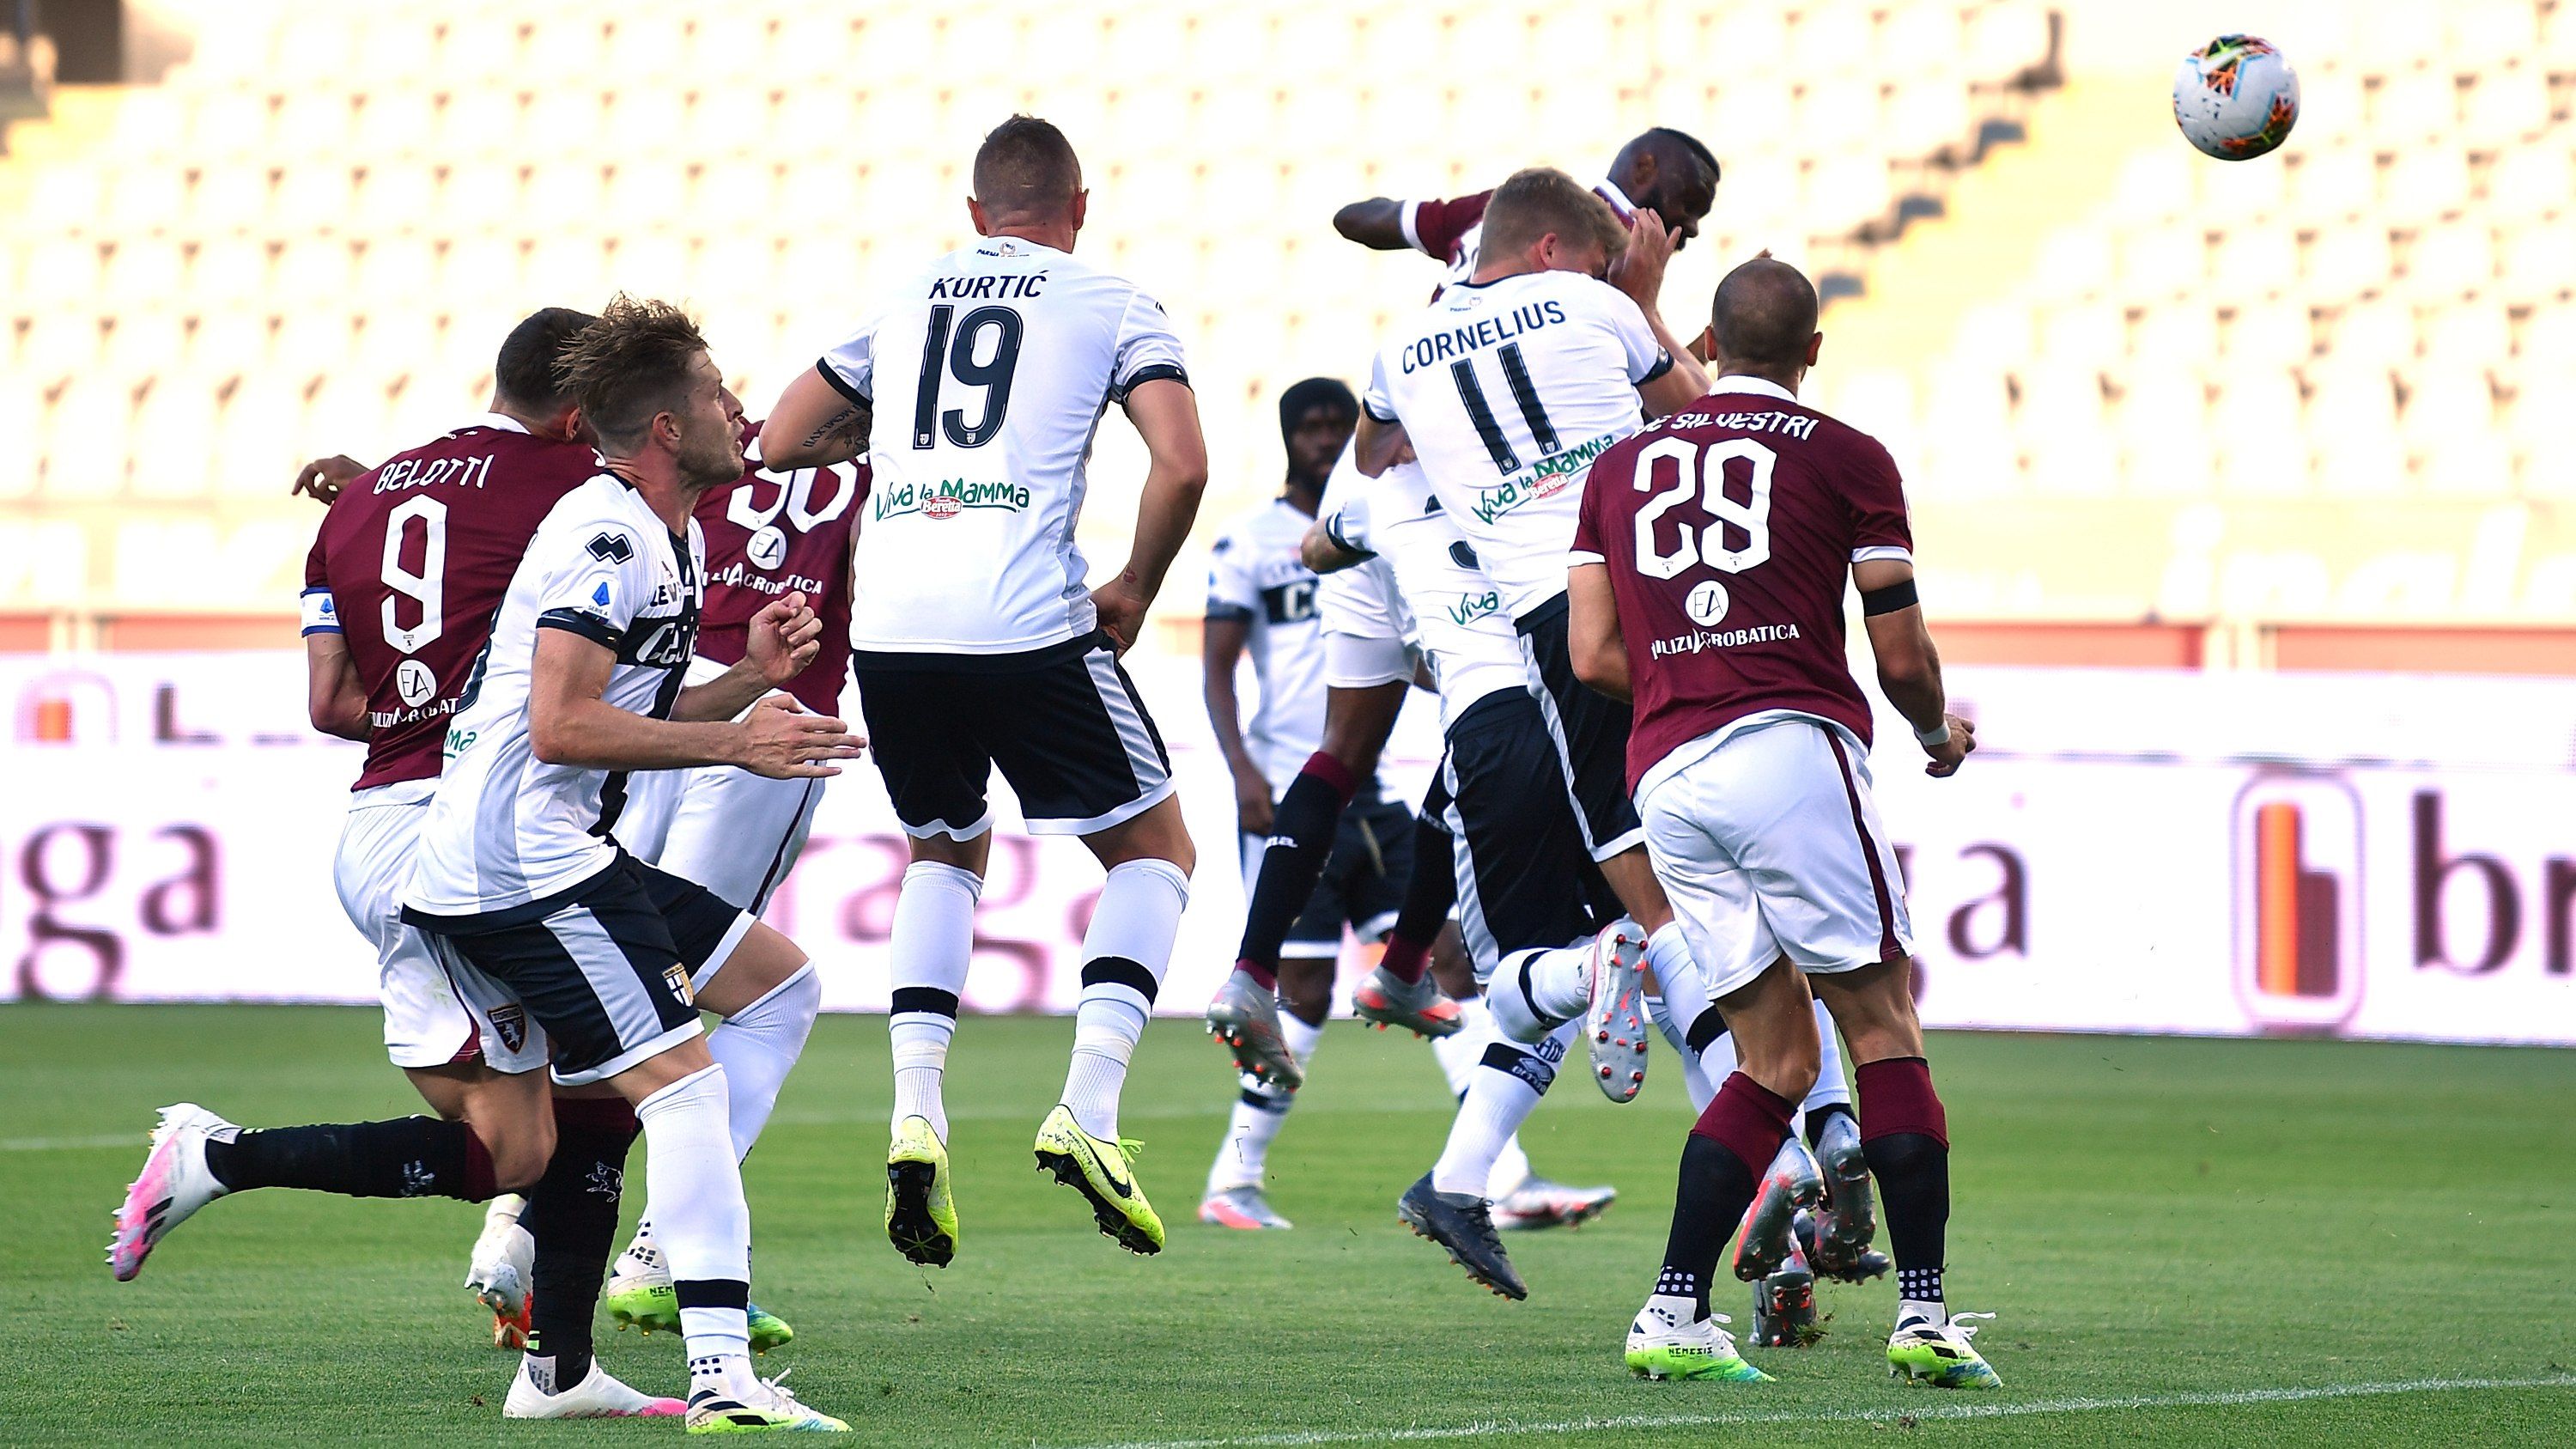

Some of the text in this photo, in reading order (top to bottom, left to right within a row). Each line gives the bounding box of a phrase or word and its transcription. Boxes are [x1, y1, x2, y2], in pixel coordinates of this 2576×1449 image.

[928, 270, 1049, 299] KURTIĆ
[1402, 301, 1566, 374] CORNELIUS
[913, 305, 1024, 450] 19
[1449, 342, 1563, 477] 11
[1671, 411, 1819, 441] SILVESTRI
[373, 454, 495, 496] BELOTTI
[876, 482, 914, 521] Viva
[920, 484, 933, 500] la
[922, 499, 962, 513] Beretta
[1471, 482, 1518, 525] Viva
[1518, 476, 1534, 490] la
[1633, 436, 1777, 580] 29
[380, 494, 447, 654] 9
[1448, 593, 1499, 625] Viva
[649, 1285, 673, 1294] NEM
[1668, 1346, 1713, 1355] NEMESIS
